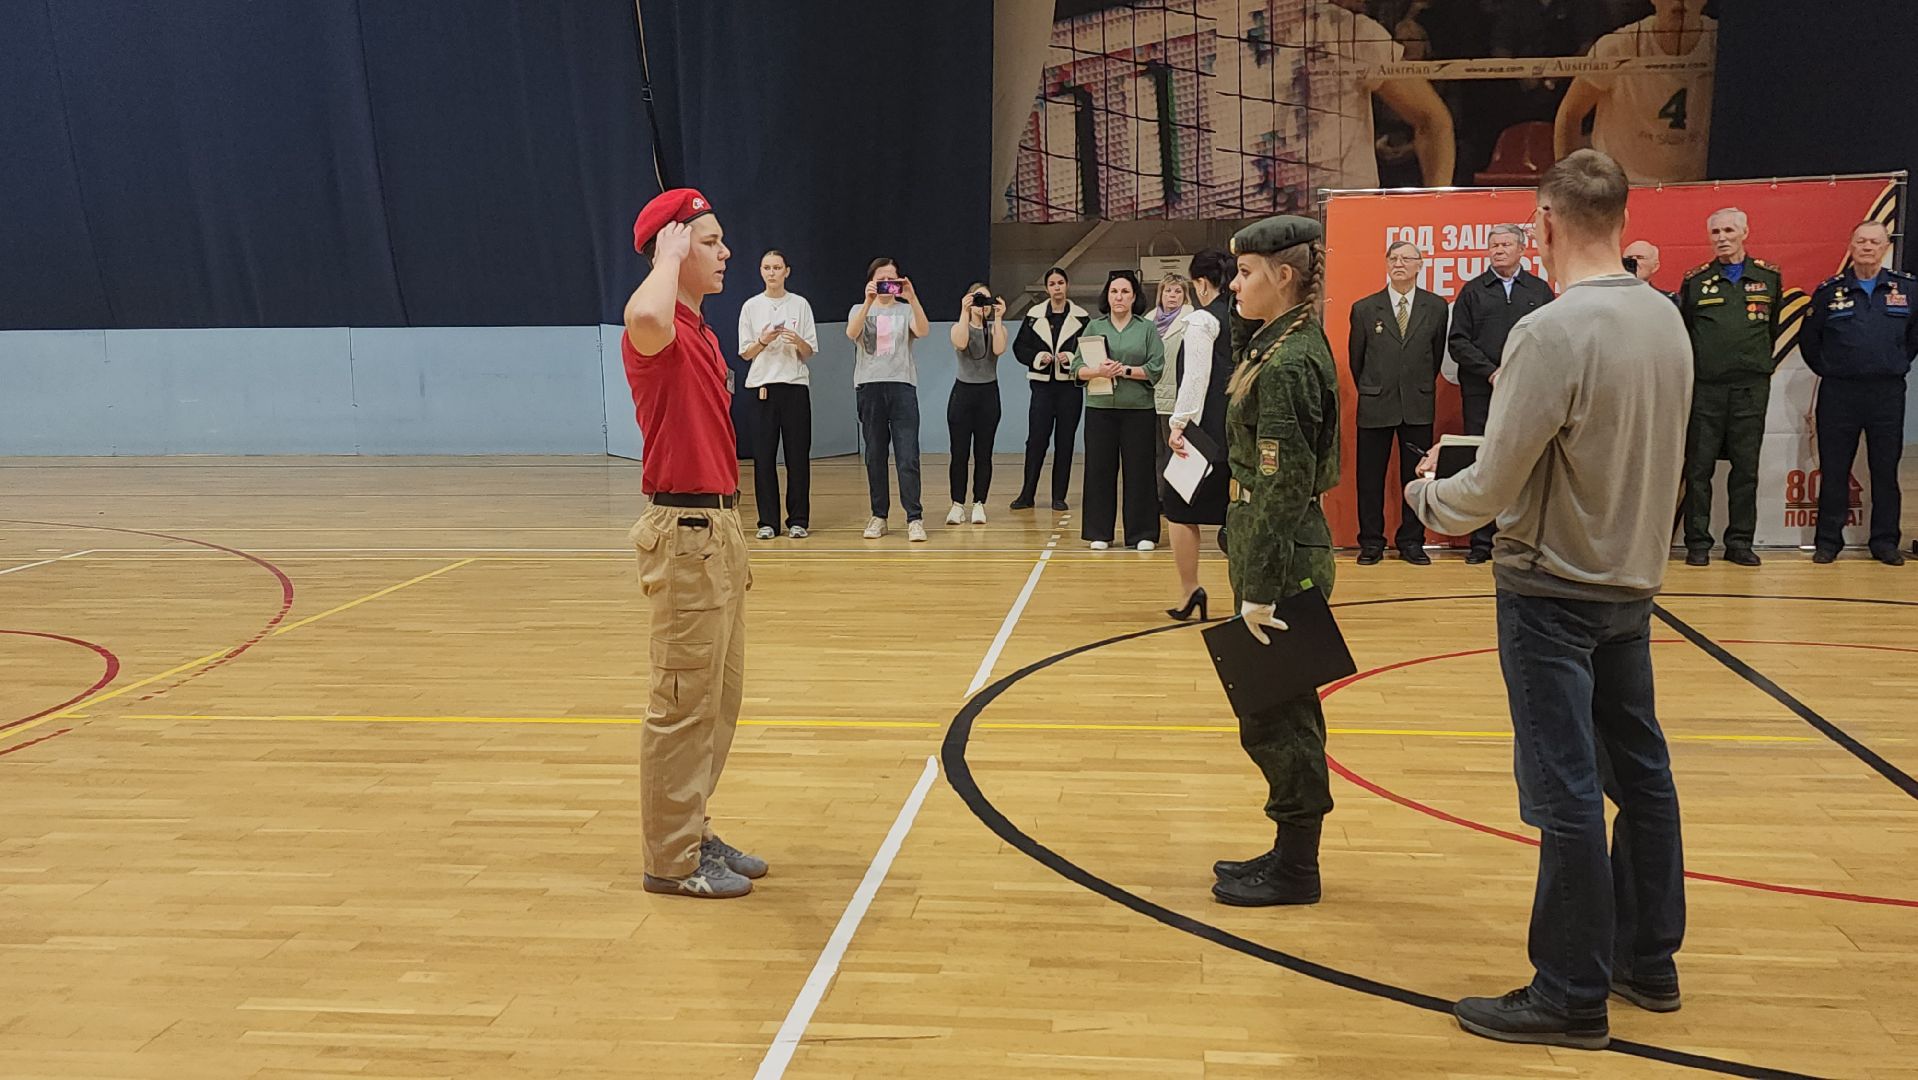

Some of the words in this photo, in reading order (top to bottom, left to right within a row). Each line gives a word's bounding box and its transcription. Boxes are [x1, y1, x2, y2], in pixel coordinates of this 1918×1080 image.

[1377, 63, 1430, 76] Austrian
[1552, 59, 1609, 72] Austrian
[1658, 87, 1688, 130] 4
[1386, 225, 1435, 256] ГОД
[1784, 509, 1863, 528] ПОБА!
